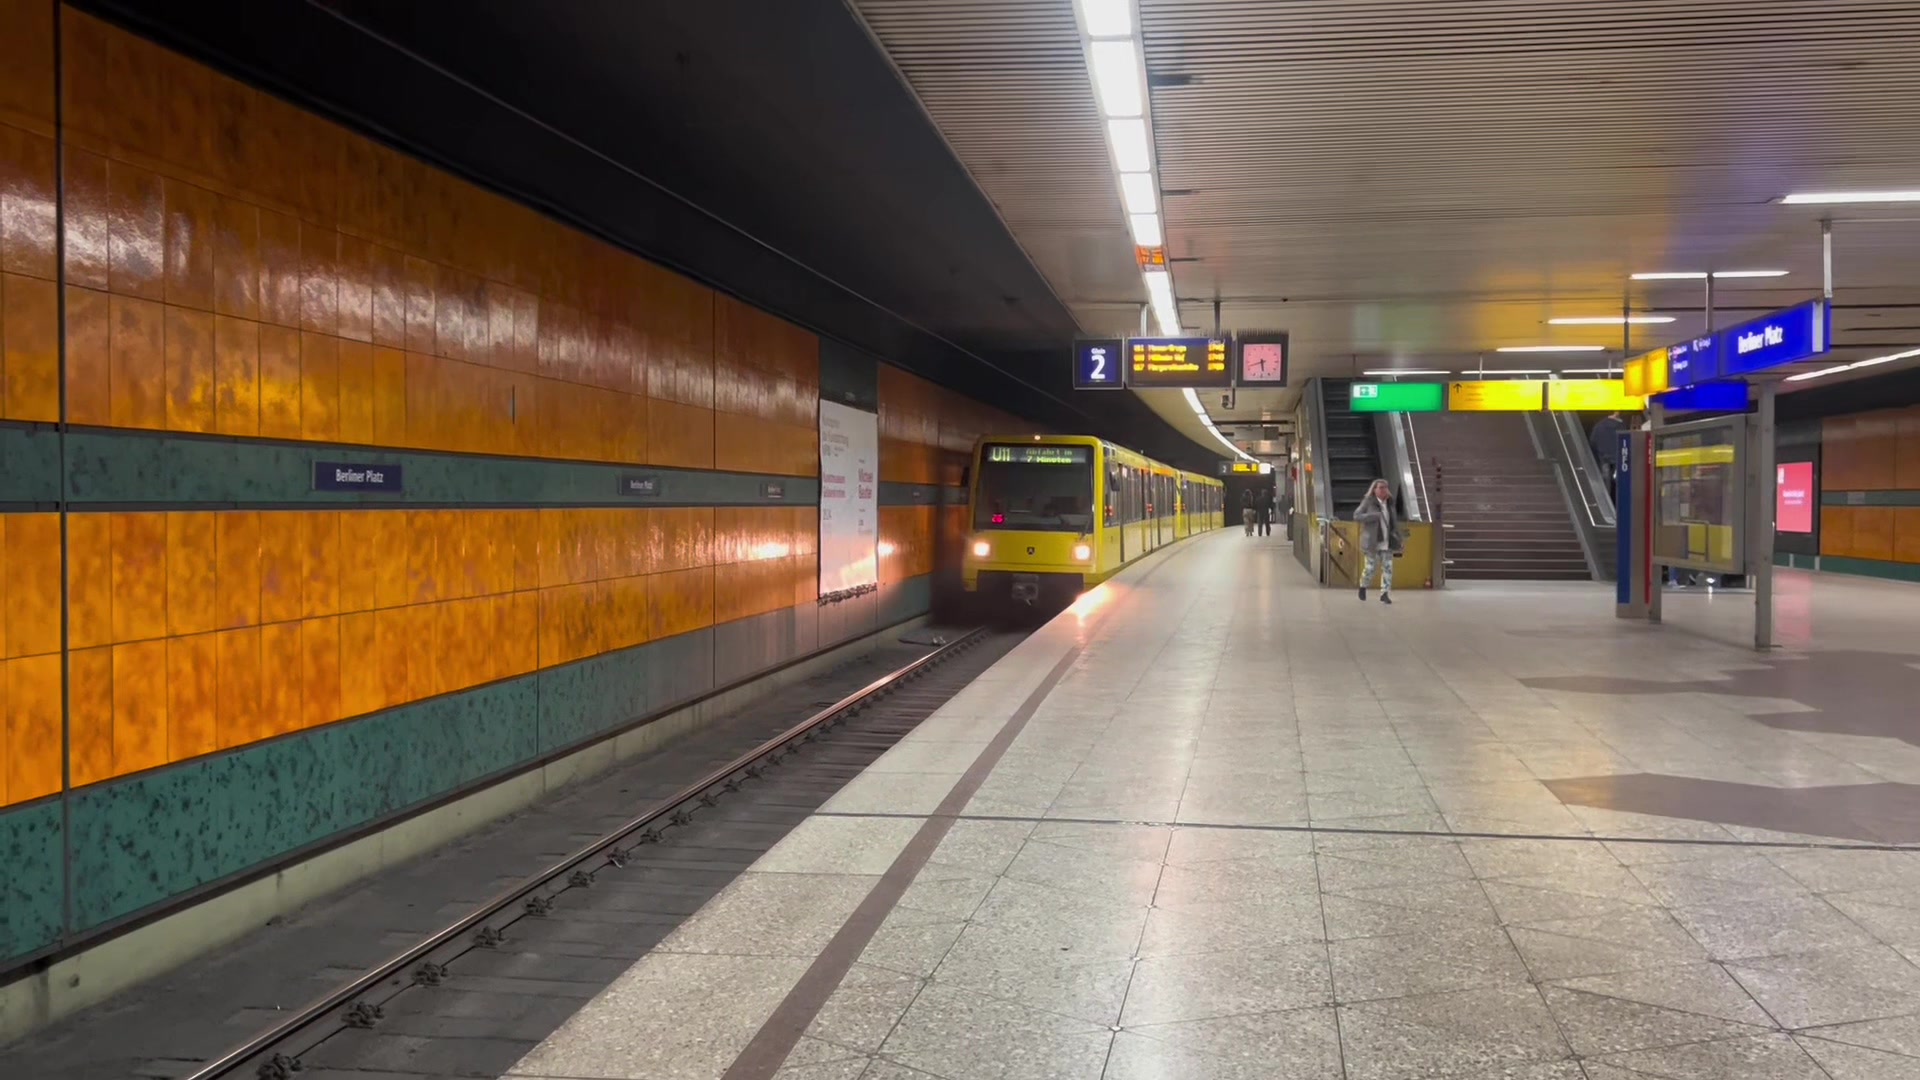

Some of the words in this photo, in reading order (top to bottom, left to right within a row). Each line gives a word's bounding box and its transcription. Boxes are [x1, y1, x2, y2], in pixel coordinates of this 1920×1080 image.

[1738, 331, 1764, 354] Berliner
[1765, 325, 1784, 347] Platz
[1091, 347, 1106, 355] Gleis
[1091, 354, 1106, 379] 2
[992, 448, 1010, 461] U11
[336, 469, 364, 482] Berliner
[366, 470, 384, 483] Platz
